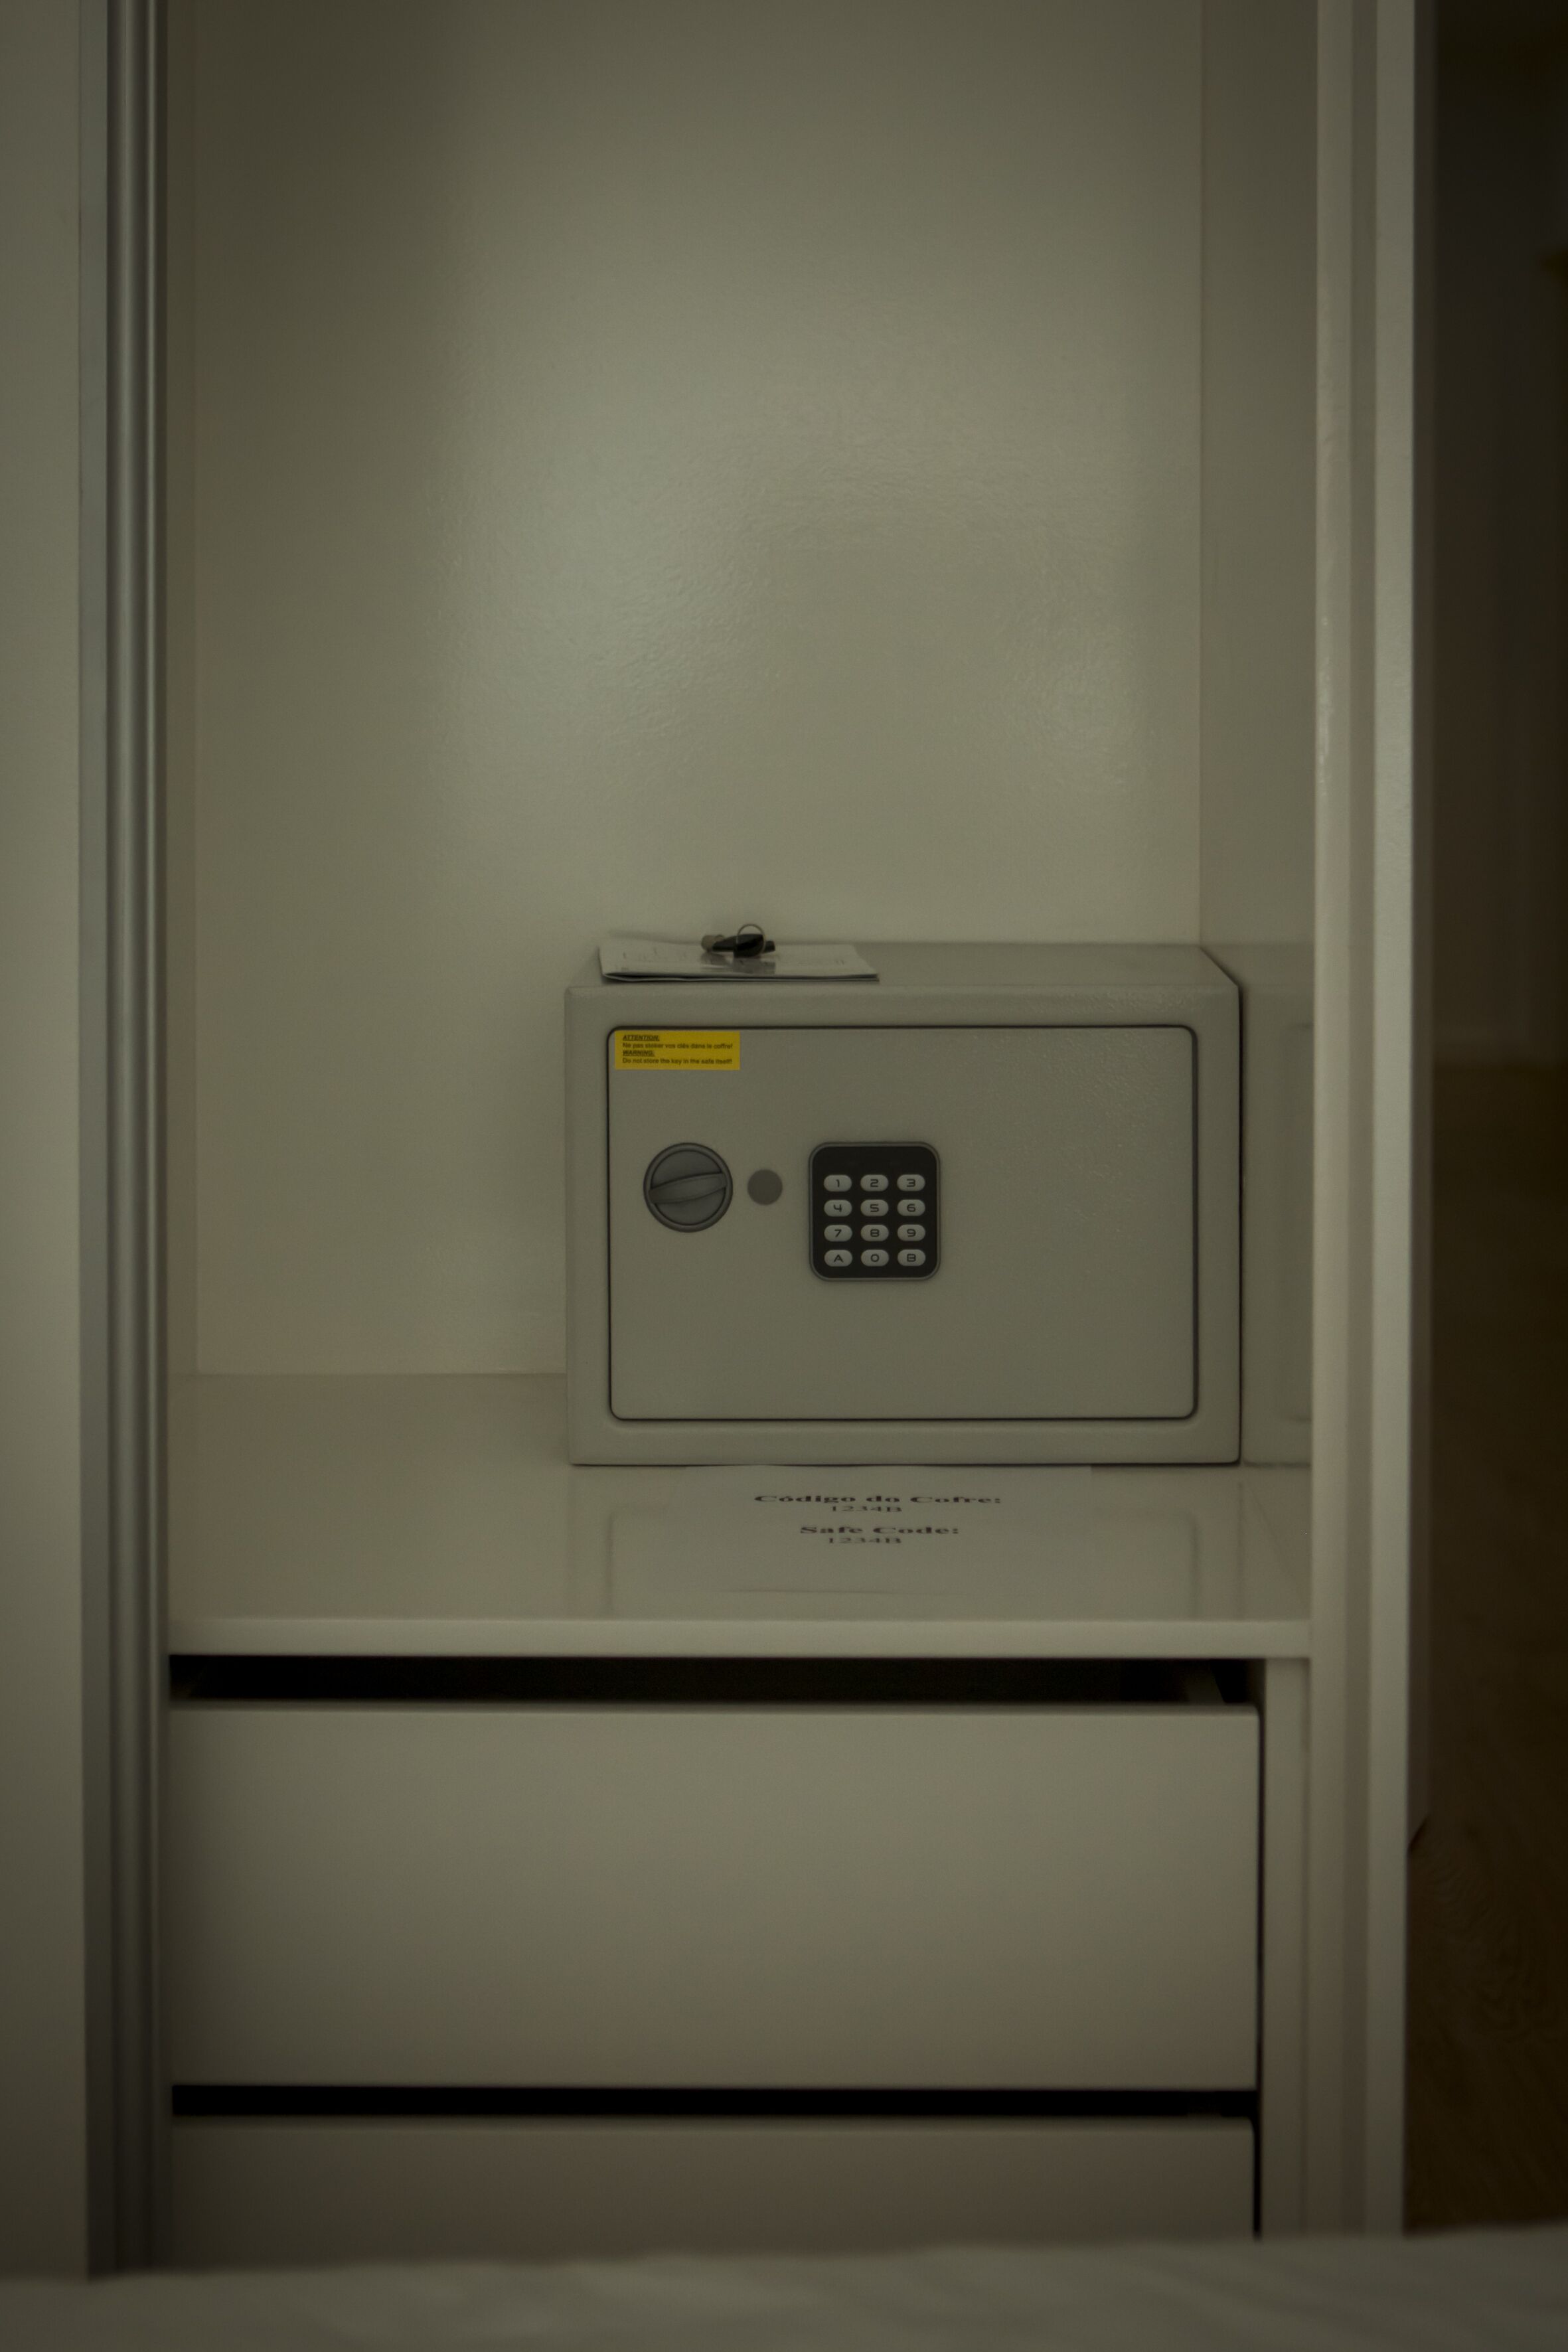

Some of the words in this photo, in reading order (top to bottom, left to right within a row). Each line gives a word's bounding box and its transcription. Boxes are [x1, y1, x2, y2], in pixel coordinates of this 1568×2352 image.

[870, 1179, 879, 1188] 2
[906, 1178, 916, 1188] 3
[870, 1204, 880, 1212] 5
[907, 1204, 916, 1212] 6
[834, 1229, 842, 1237] 7
[870, 1229, 880, 1237] 8
[906, 1229, 916, 1237] 9
[833, 1254, 844, 1263] A
[907, 1253, 916, 1262] B
[754, 1495, 856, 1504] Código
[873, 1526, 959, 1535] Code:
